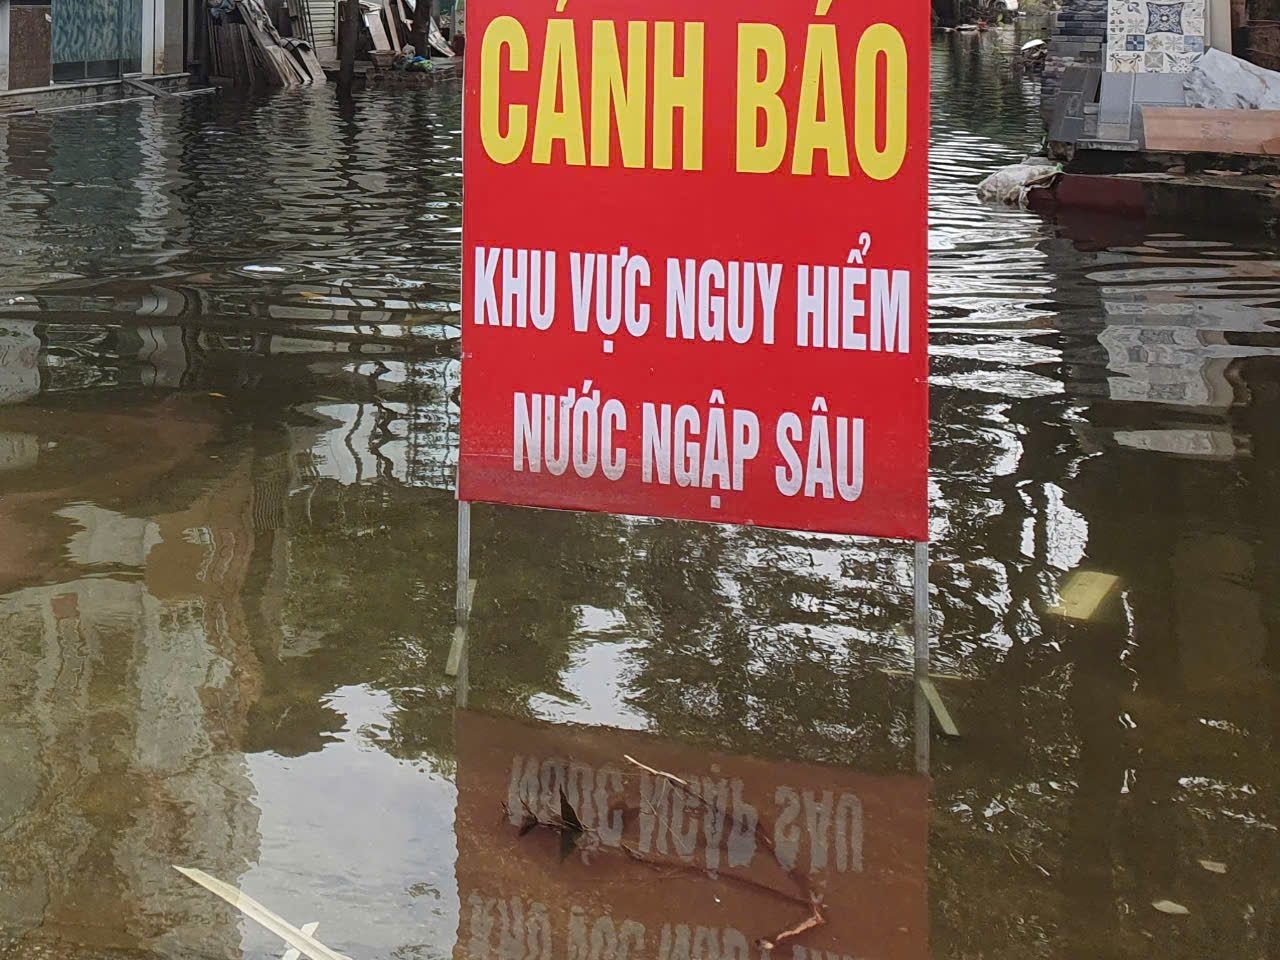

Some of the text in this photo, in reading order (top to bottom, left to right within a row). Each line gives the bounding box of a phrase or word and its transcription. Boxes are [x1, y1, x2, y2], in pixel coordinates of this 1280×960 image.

[474, 231, 910, 353] KHU VỰC NGUY HIỂM
[513, 379, 864, 508] NƯỚC NGẬP SÂU
